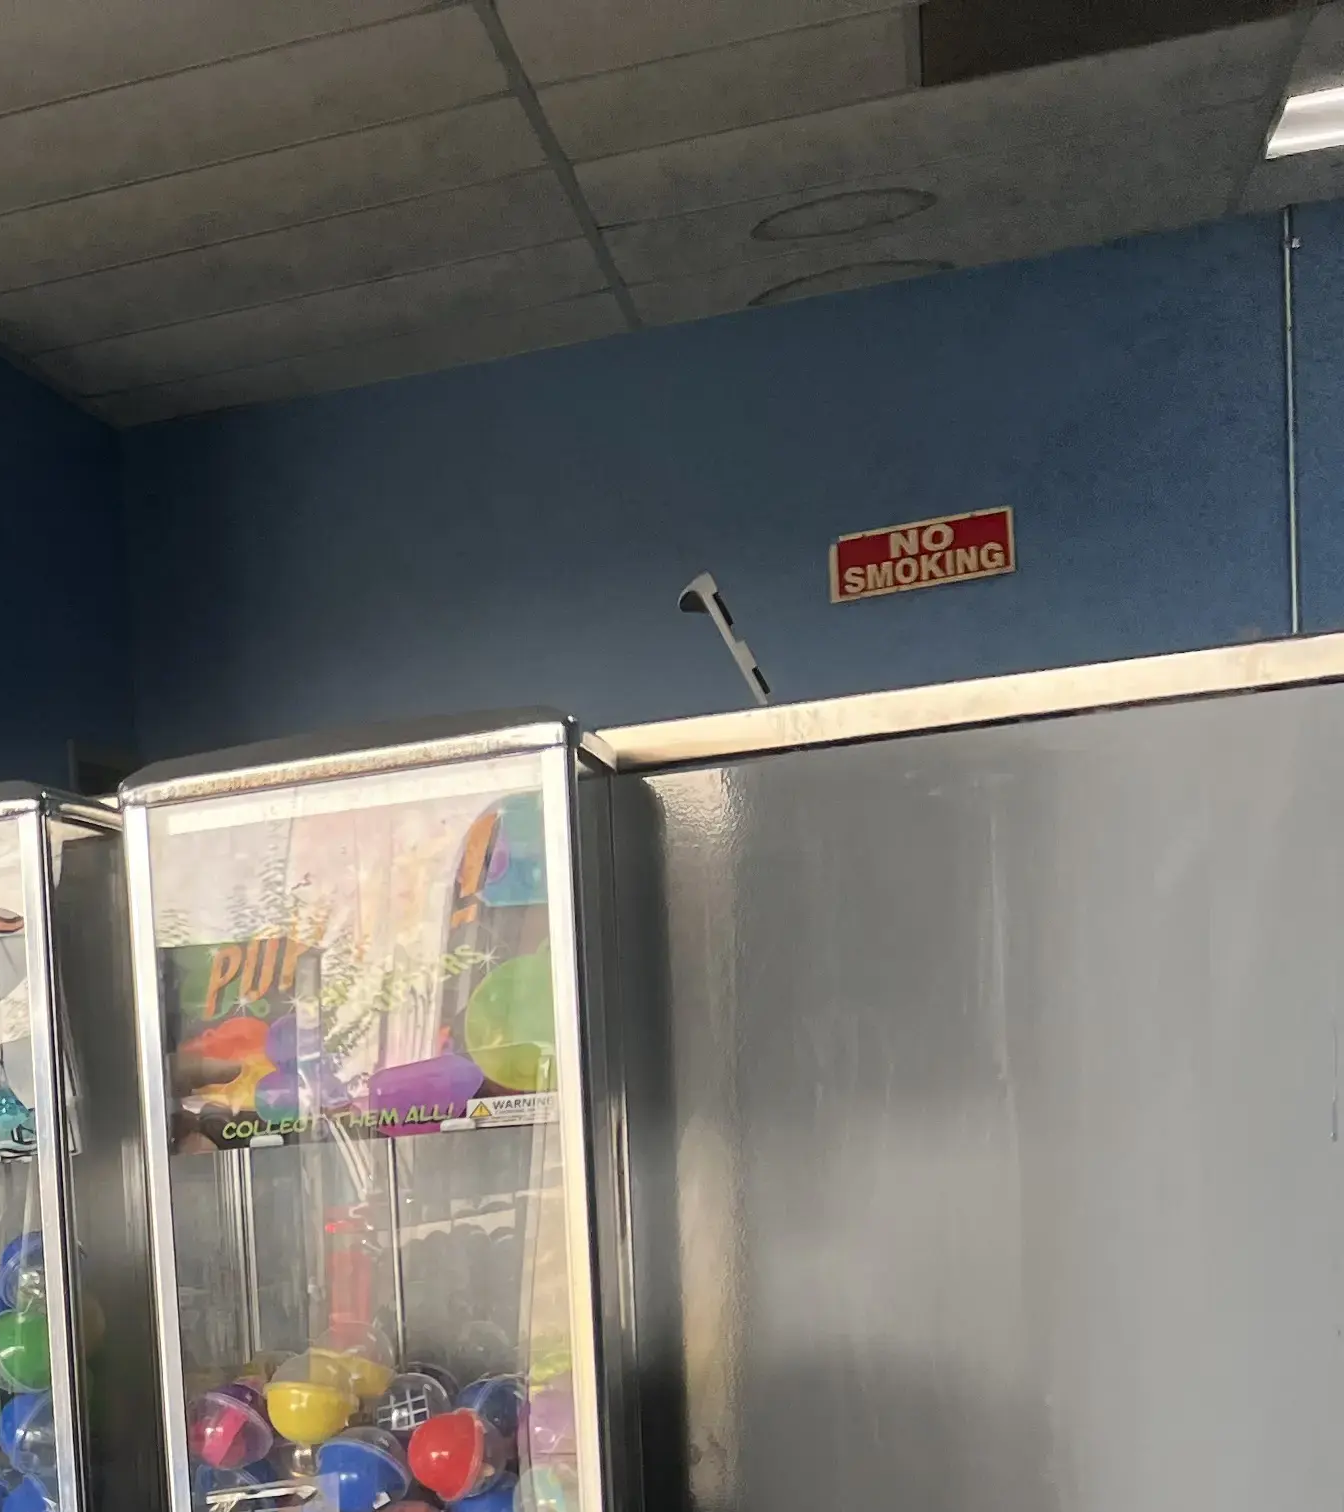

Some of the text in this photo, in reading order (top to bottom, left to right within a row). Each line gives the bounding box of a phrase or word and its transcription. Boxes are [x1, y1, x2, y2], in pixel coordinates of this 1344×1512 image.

[889, 523, 955, 559] NO
[843, 541, 1005, 594] SMOKING
[221, 1101, 455, 1140] COLLECT THEM ALL!
[493, 1097, 554, 1110] WARNING
